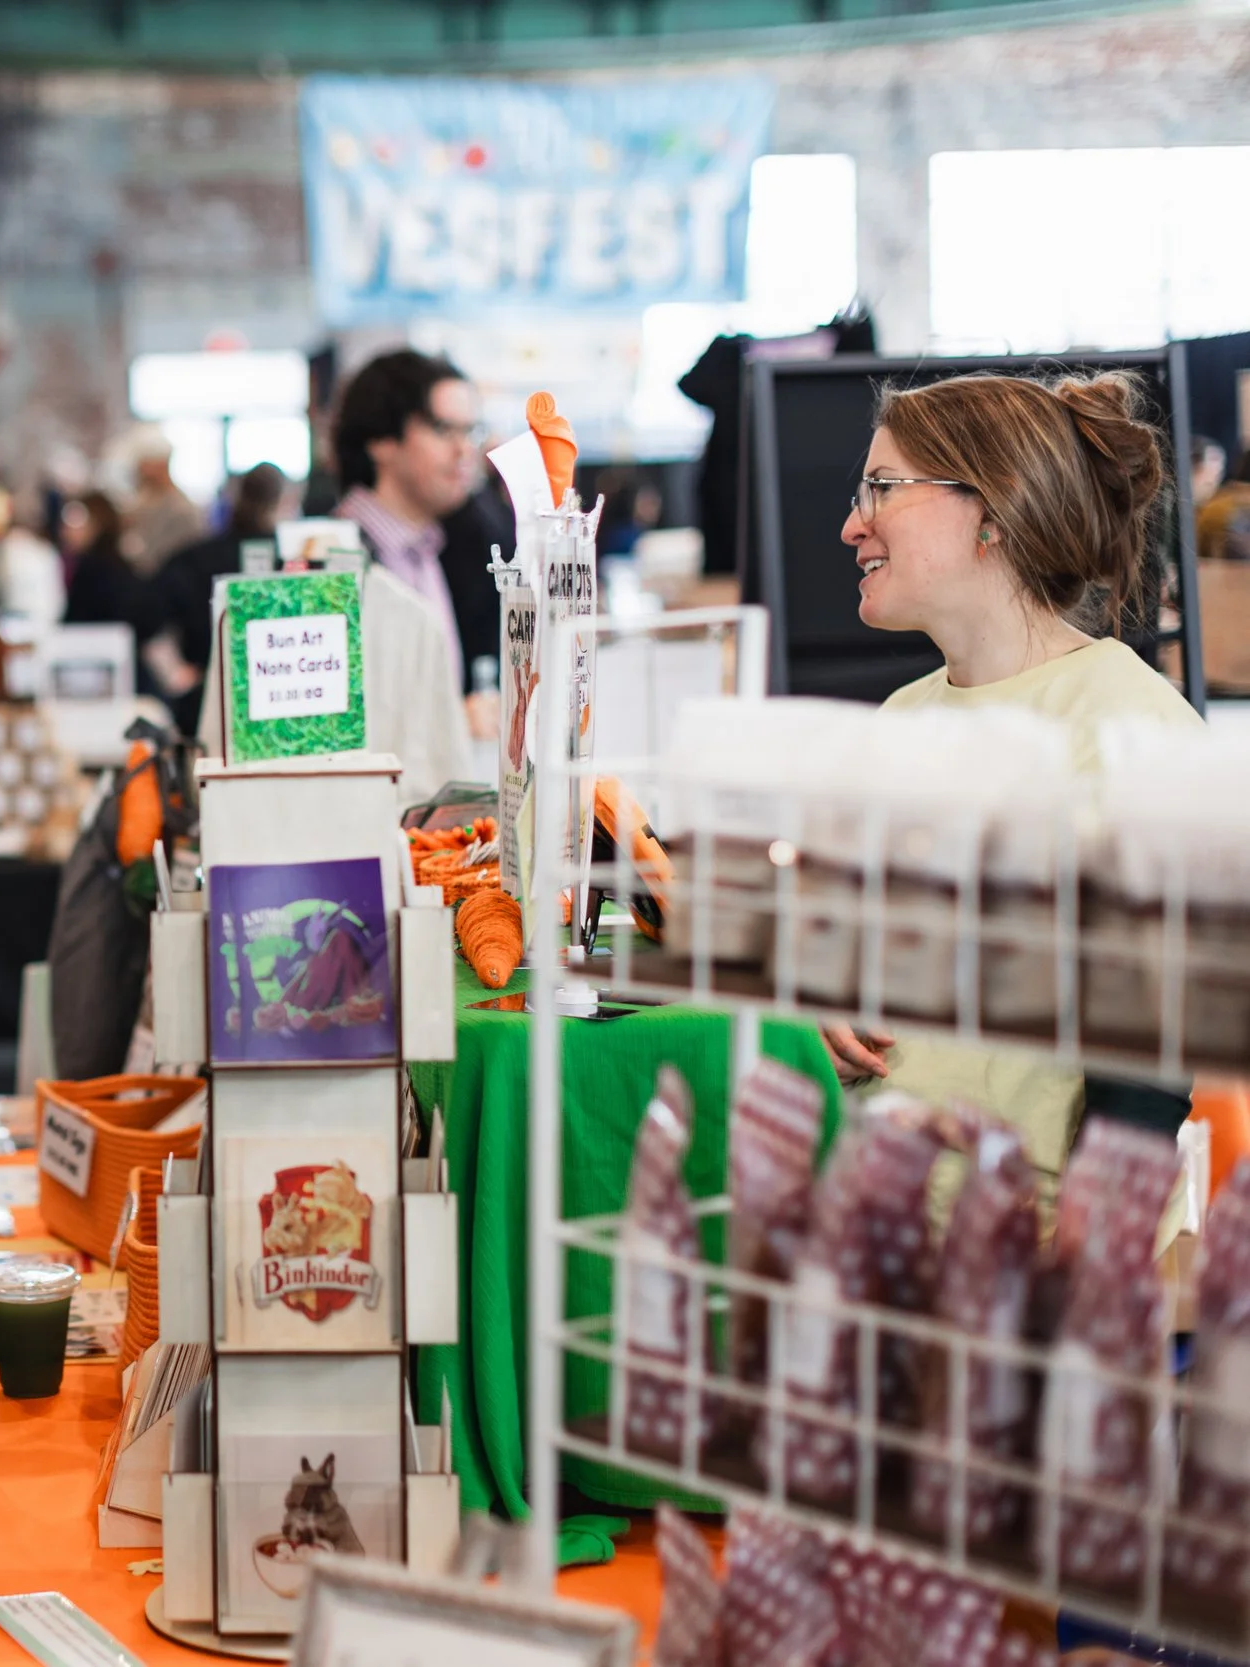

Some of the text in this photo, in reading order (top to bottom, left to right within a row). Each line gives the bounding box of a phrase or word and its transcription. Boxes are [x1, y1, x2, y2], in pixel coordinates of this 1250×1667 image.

[267, 631, 323, 648] Bun Art
[255, 654, 340, 676] Note Cards
